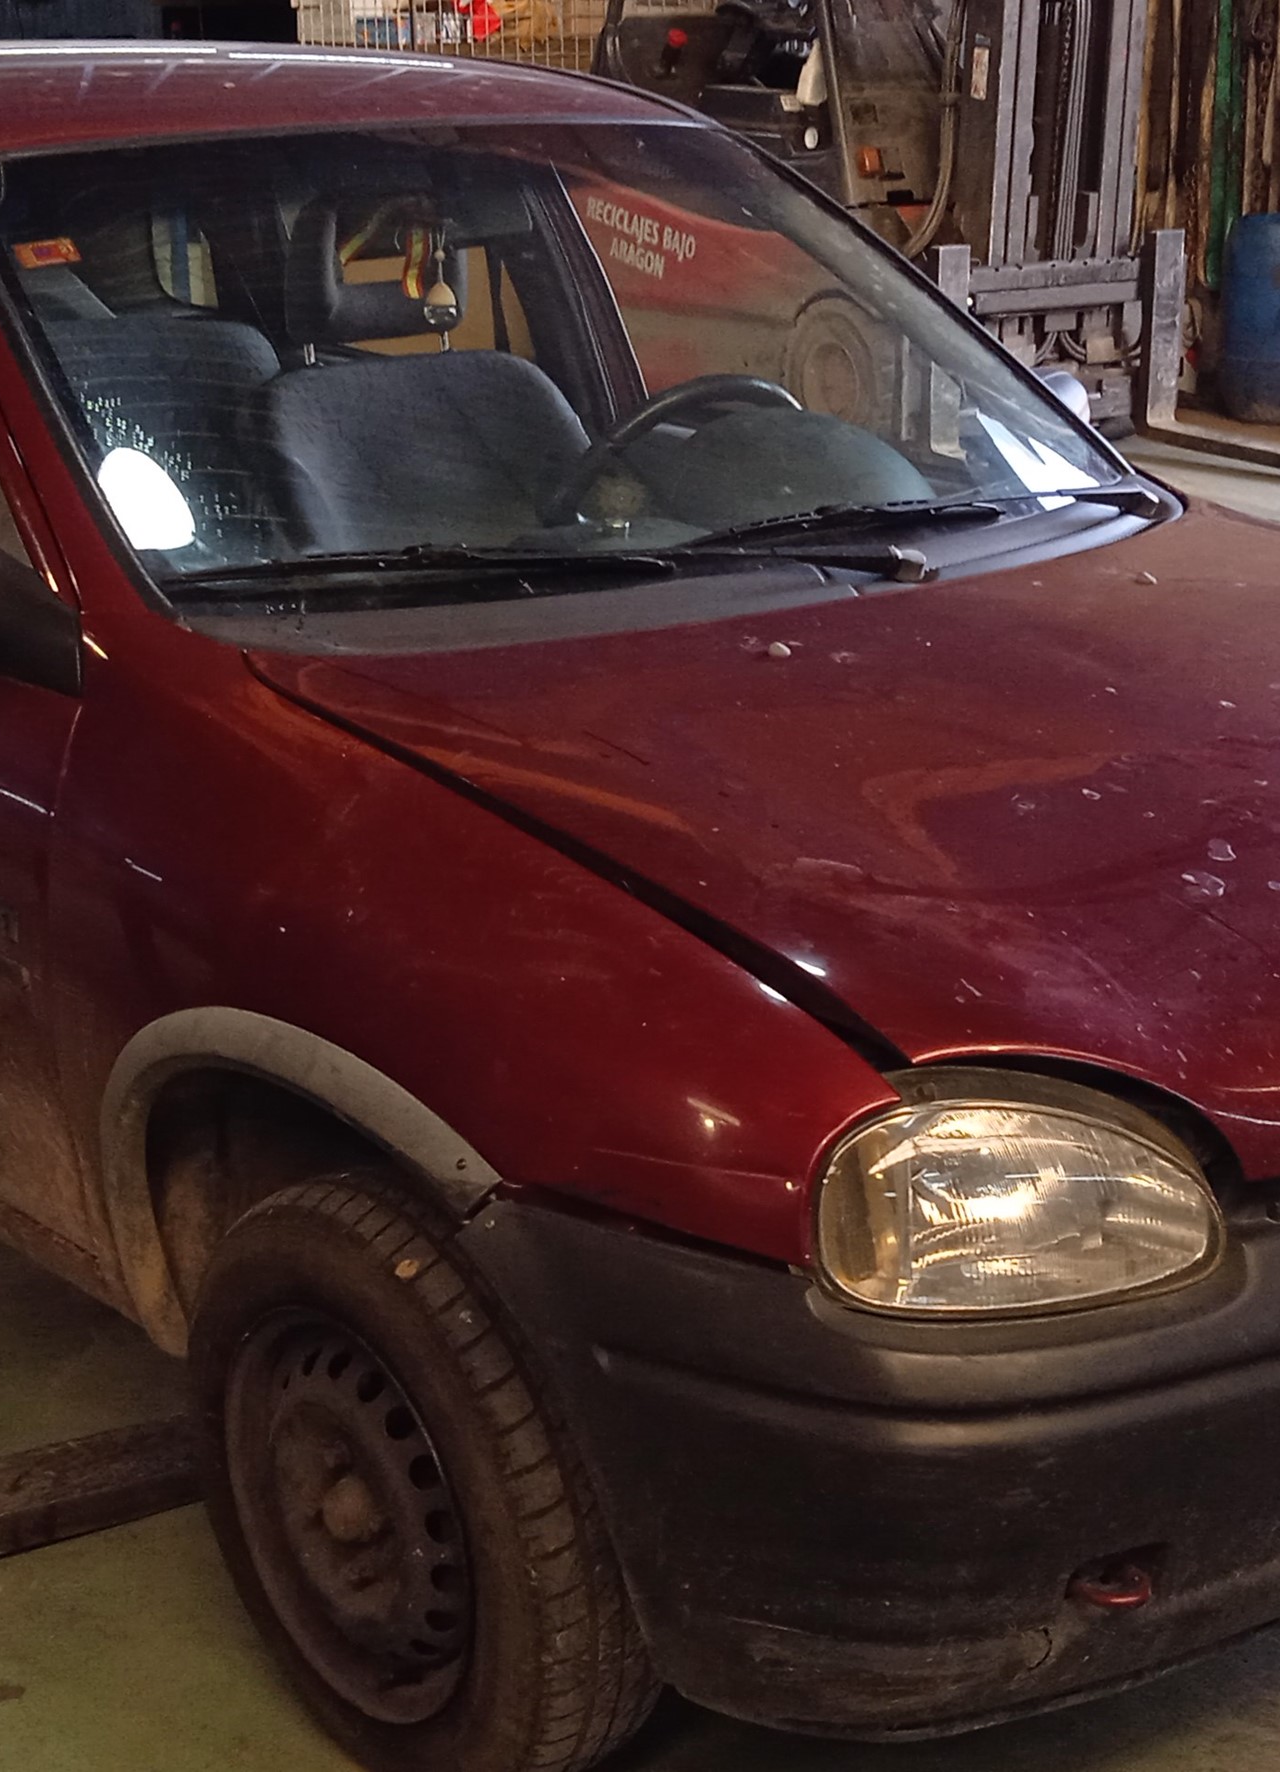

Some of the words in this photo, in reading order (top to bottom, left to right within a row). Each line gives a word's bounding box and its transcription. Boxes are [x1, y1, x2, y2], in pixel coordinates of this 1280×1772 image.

[586, 196, 660, 247] RECICLAJES
[662, 225, 696, 262] BAJO
[609, 237, 665, 280] ARAGON
